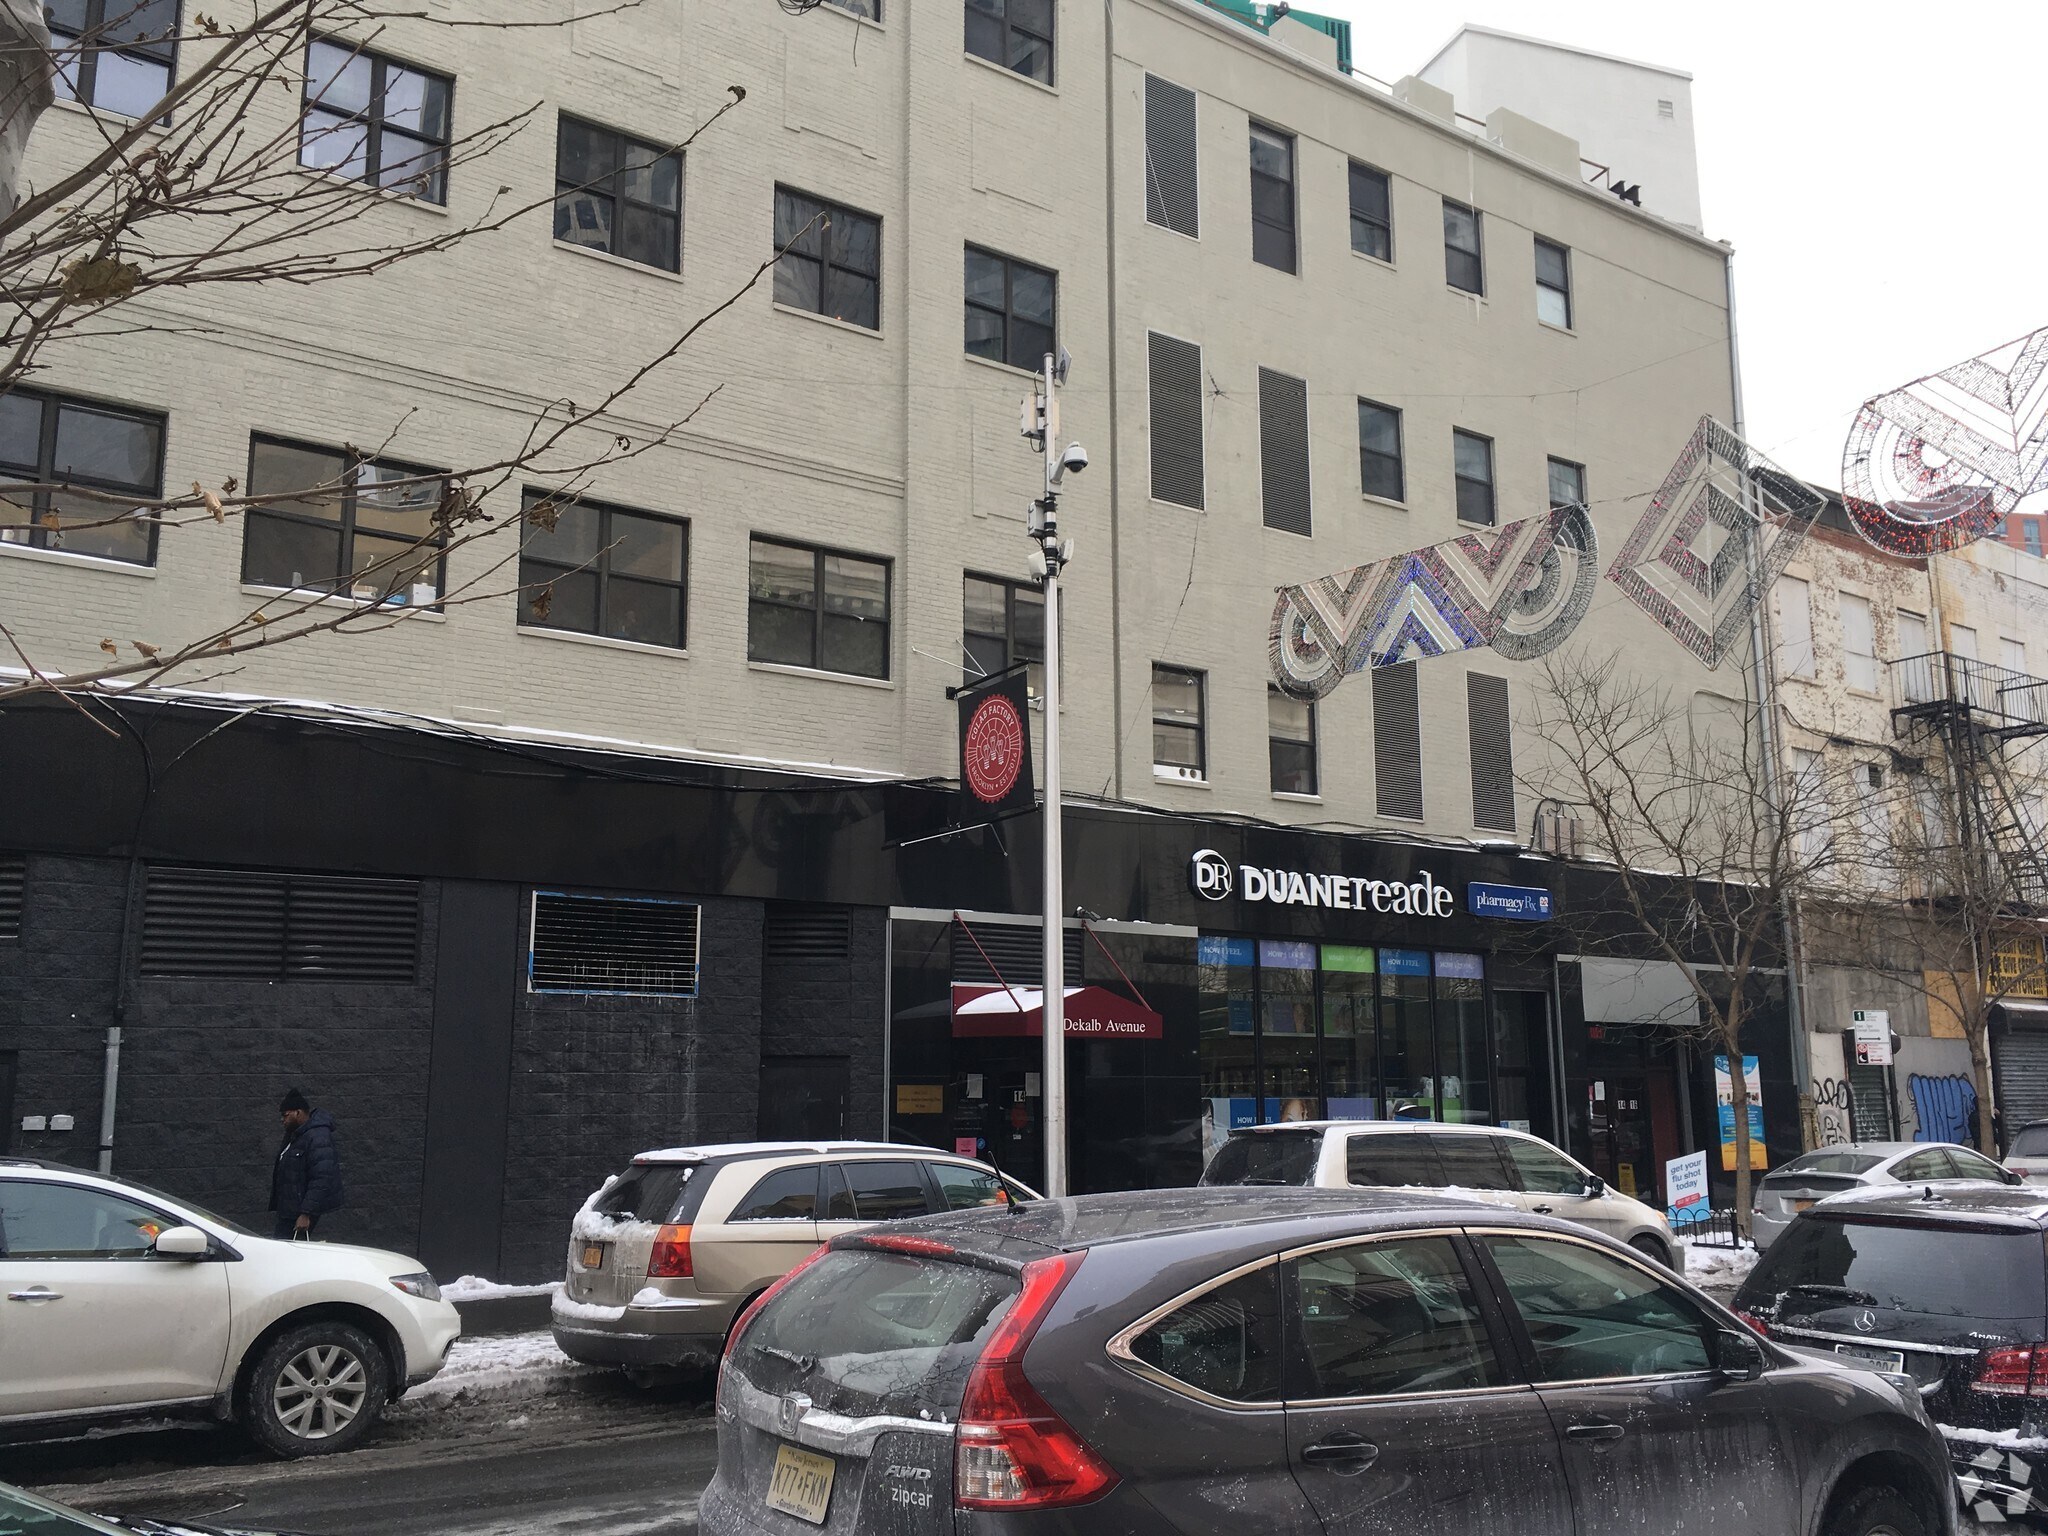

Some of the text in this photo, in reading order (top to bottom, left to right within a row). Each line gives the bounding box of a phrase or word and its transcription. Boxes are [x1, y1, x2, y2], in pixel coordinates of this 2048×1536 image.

[971, 705, 1014, 740] COLAB FACTORY
[971, 752, 1017, 790] BROOKLYN EST 2016
[1476, 891, 1524, 911] pharmacy
[1204, 946, 1220, 954] HOW
[1226, 947, 1242, 956] FEEL
[1387, 958, 1401, 966] HOW
[1063, 1018, 1146, 1033] Dekalb Avenue
[1670, 1160, 1702, 1175] get your
[1672, 1169, 1701, 1183] flu shot
[1676, 1180, 1698, 1190] today
[884, 1464, 932, 1481] AWD
[891, 1485, 933, 1507] zipcar
[779, 1498, 809, 1515] Garden State
